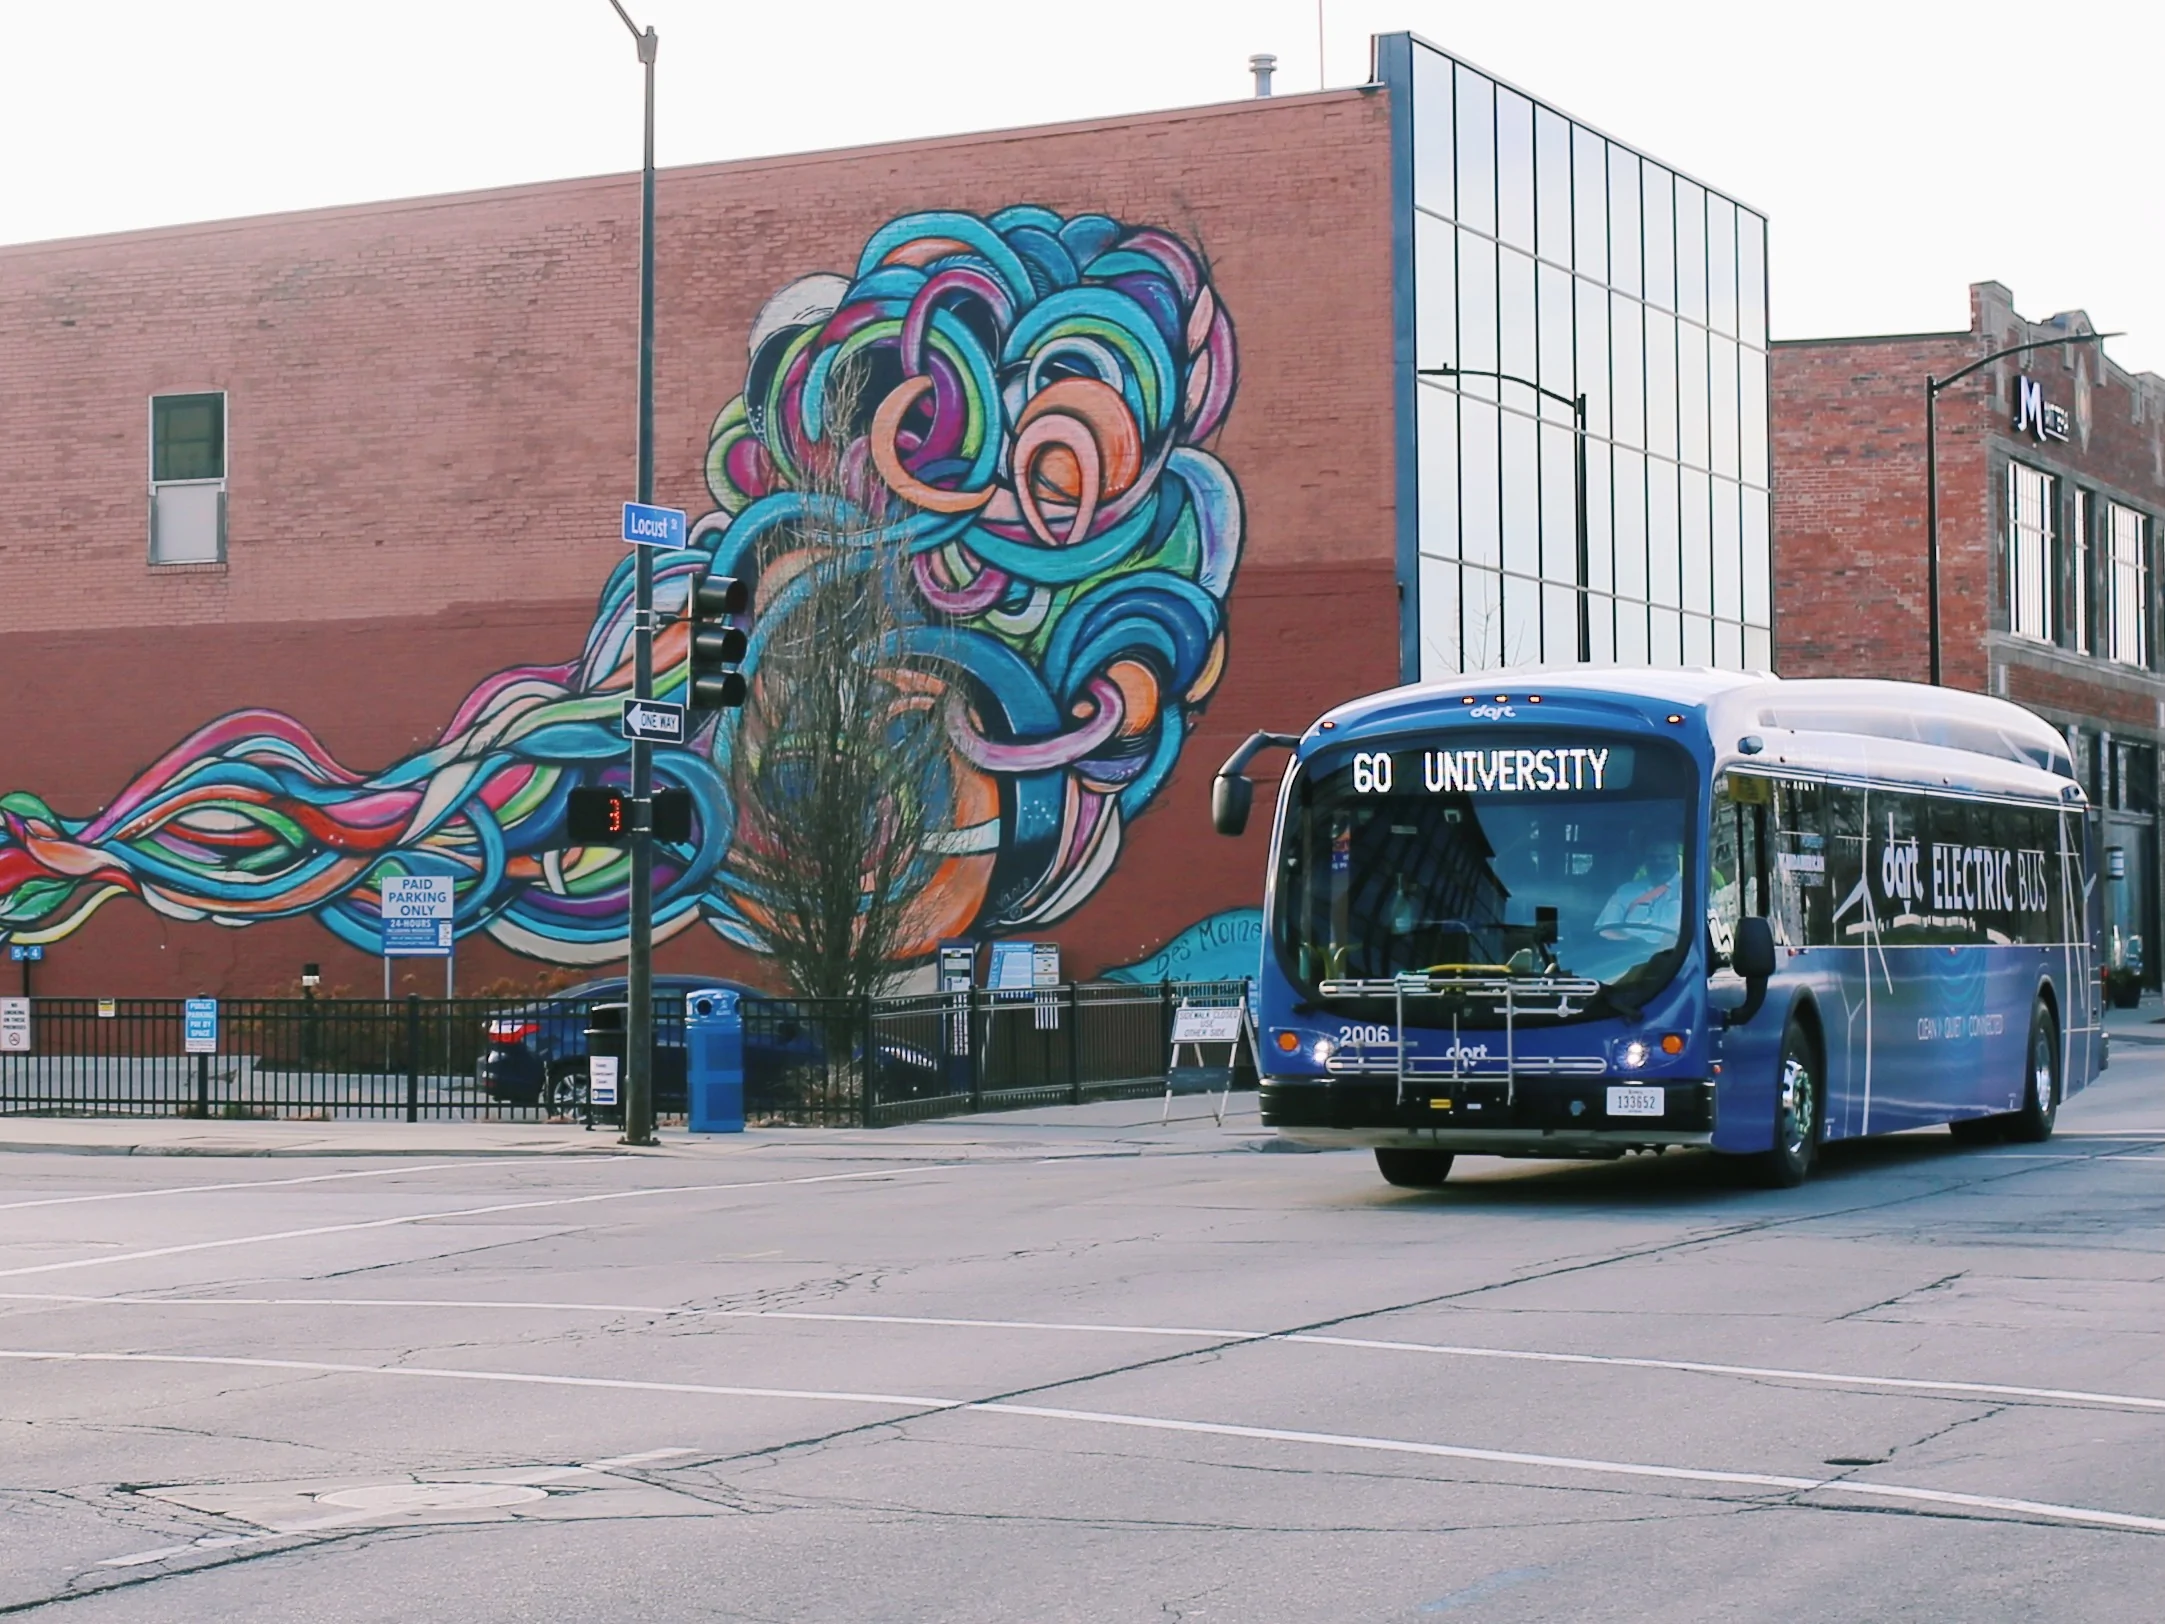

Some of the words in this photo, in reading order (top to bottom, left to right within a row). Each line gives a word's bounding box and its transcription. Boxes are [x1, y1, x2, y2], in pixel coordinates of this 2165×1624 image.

[631, 512, 668, 539] Locust
[1470, 704, 1516, 721] dart
[641, 713, 657, 728] ONE
[660, 715, 677, 730] WAY
[1352, 752, 1393, 793] 60
[1424, 748, 1608, 793] UNIVERSITY
[1882, 811, 1924, 903] dart
[1932, 846, 2014, 912] ELECTRIC
[2017, 849, 2048, 912] BUS
[402, 879, 433, 890] PAID
[388, 891, 447, 903] PARKING
[400, 905, 436, 916] ONLY
[390, 919, 432, 928] 24-HOURS
[1152, 940, 1191, 976] Des
[1179, 1011, 1210, 1020] SIDEWALK
[1213, 1010, 1239, 1019] CLOSED
[1200, 1020, 1214, 1028] USE
[1184, 1029, 1207, 1037] OTHER
[1210, 1029, 1226, 1037] SIDE
[1339, 1025, 1390, 1046] 2006
[1618, 1095, 1656, 1109] 133652
